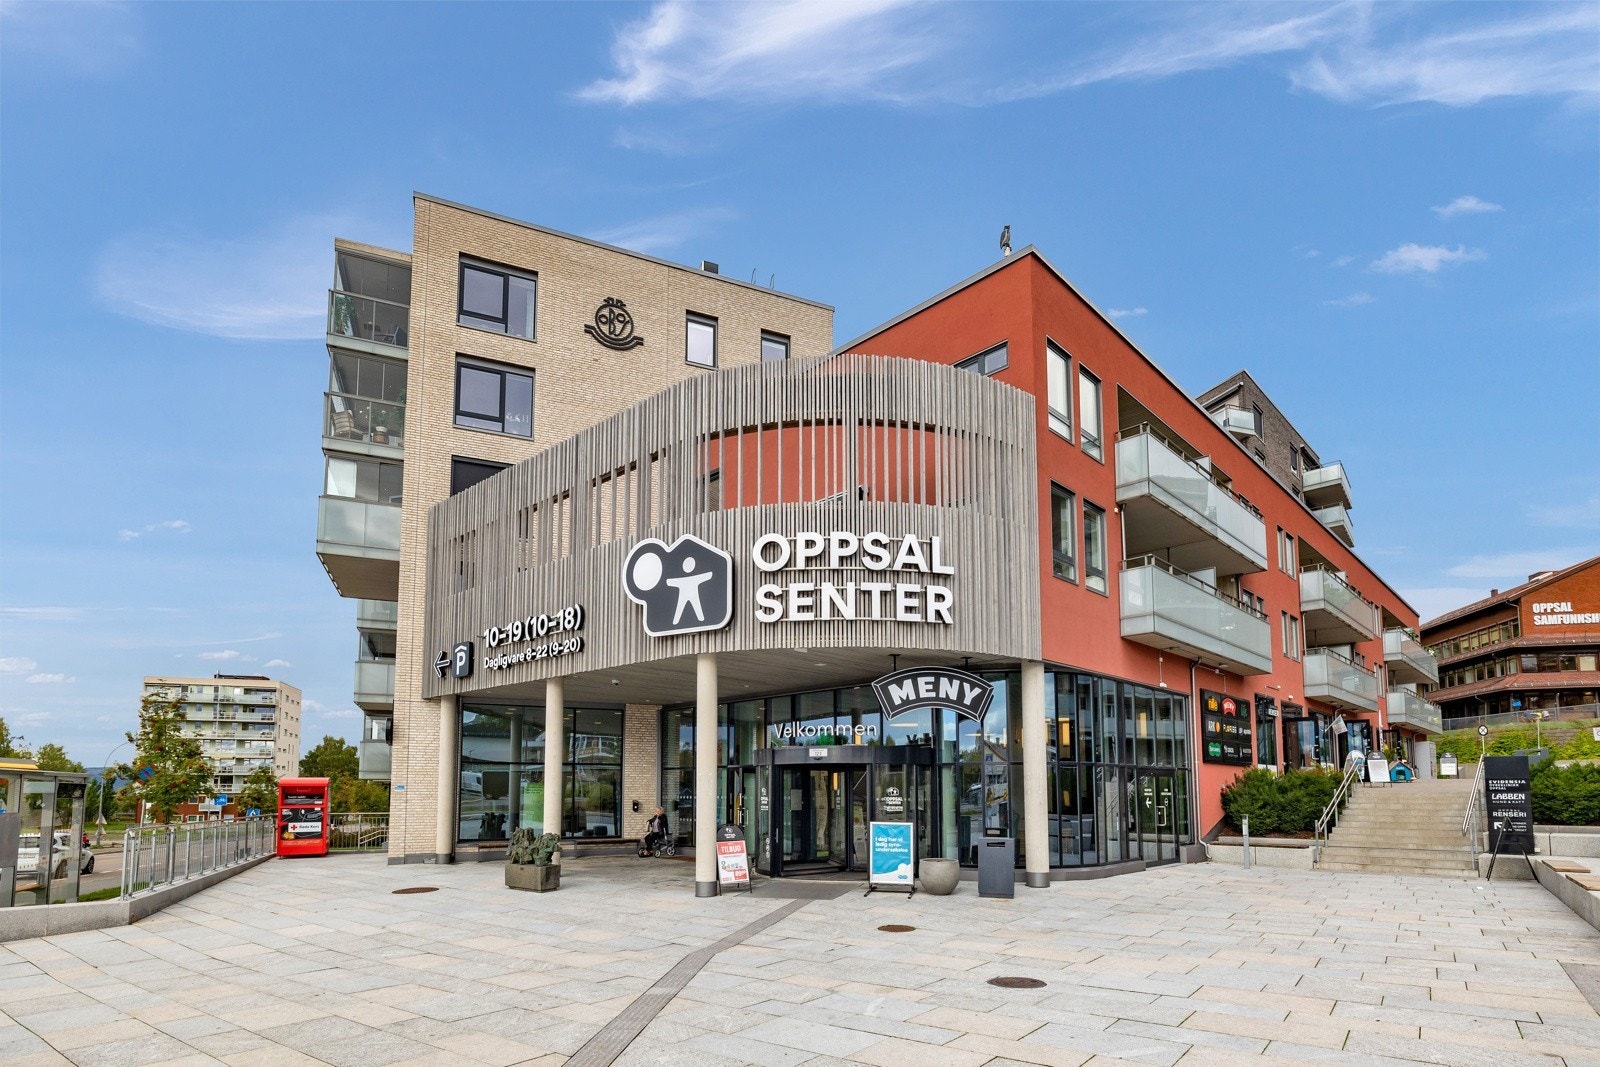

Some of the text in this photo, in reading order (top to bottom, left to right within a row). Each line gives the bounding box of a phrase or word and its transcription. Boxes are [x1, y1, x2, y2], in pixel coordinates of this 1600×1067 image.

[752, 531, 955, 575] OPPSAL
[755, 582, 954, 624] SENTER
[1532, 602, 1573, 613] OPPSAL
[1533, 613, 1600, 626] SAMFUNNSH
[483, 621, 522, 648] 10-19
[483, 636, 581, 670] Dagligvare 8-22 (9-20)
[887, 676, 982, 706] MENY
[774, 720, 877, 738] Velkommen
[721, 845, 741, 853] TILBUD
